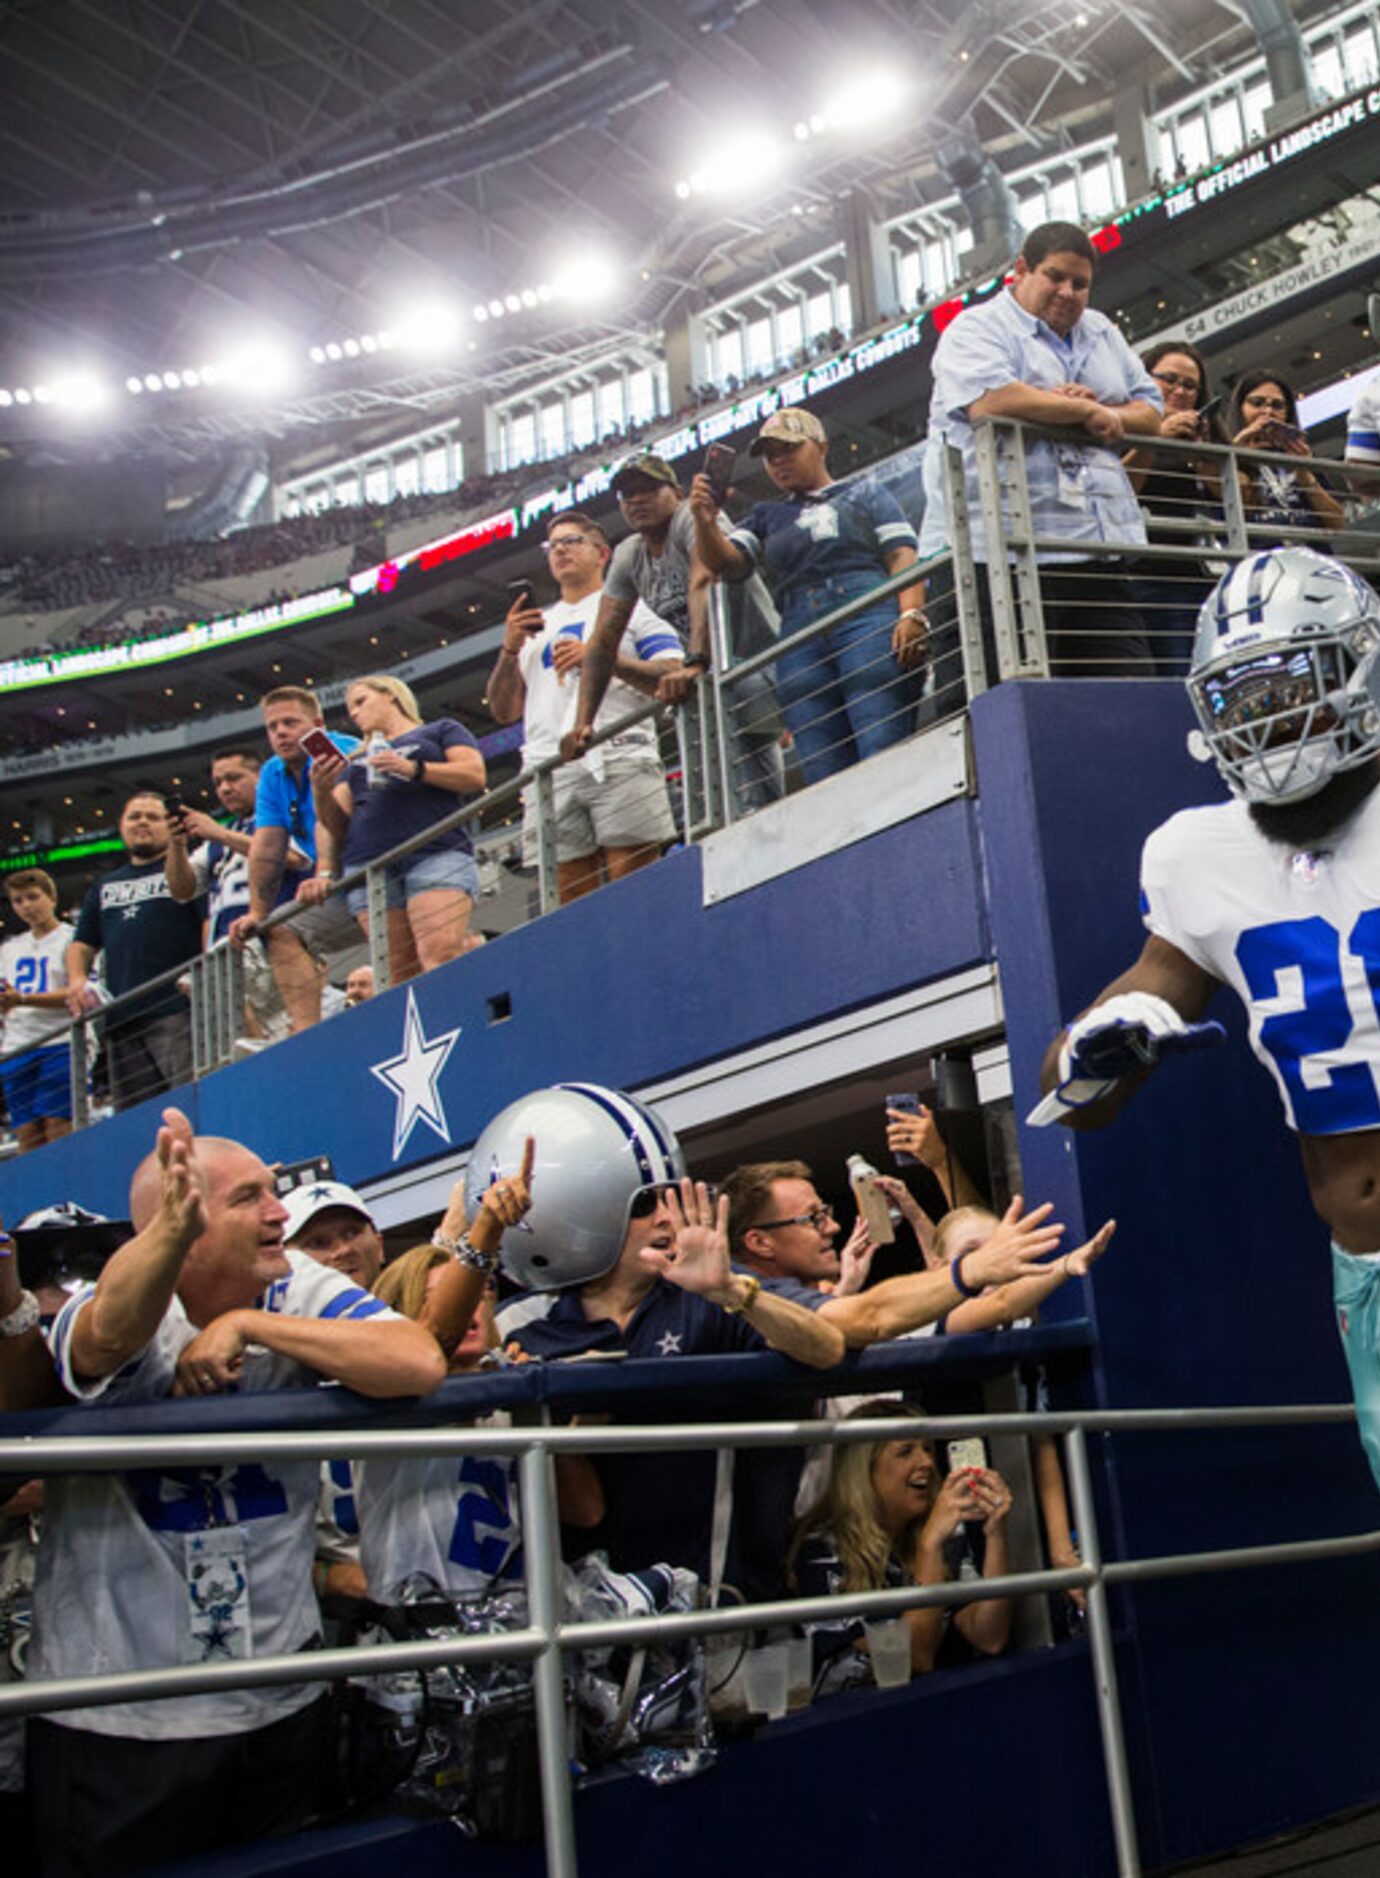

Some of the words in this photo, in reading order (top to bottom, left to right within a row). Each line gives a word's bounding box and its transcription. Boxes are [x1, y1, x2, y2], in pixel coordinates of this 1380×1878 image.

[1164, 187, 1196, 219] THE
[1196, 151, 1270, 203] OFFICIAL
[1269, 99, 1367, 165] LANDSCAPE
[1184, 317, 1206, 338] 54
[1213, 289, 1269, 325] CHUCK
[1273, 252, 1343, 298] HOWLEY
[15, 956, 49, 993] 21
